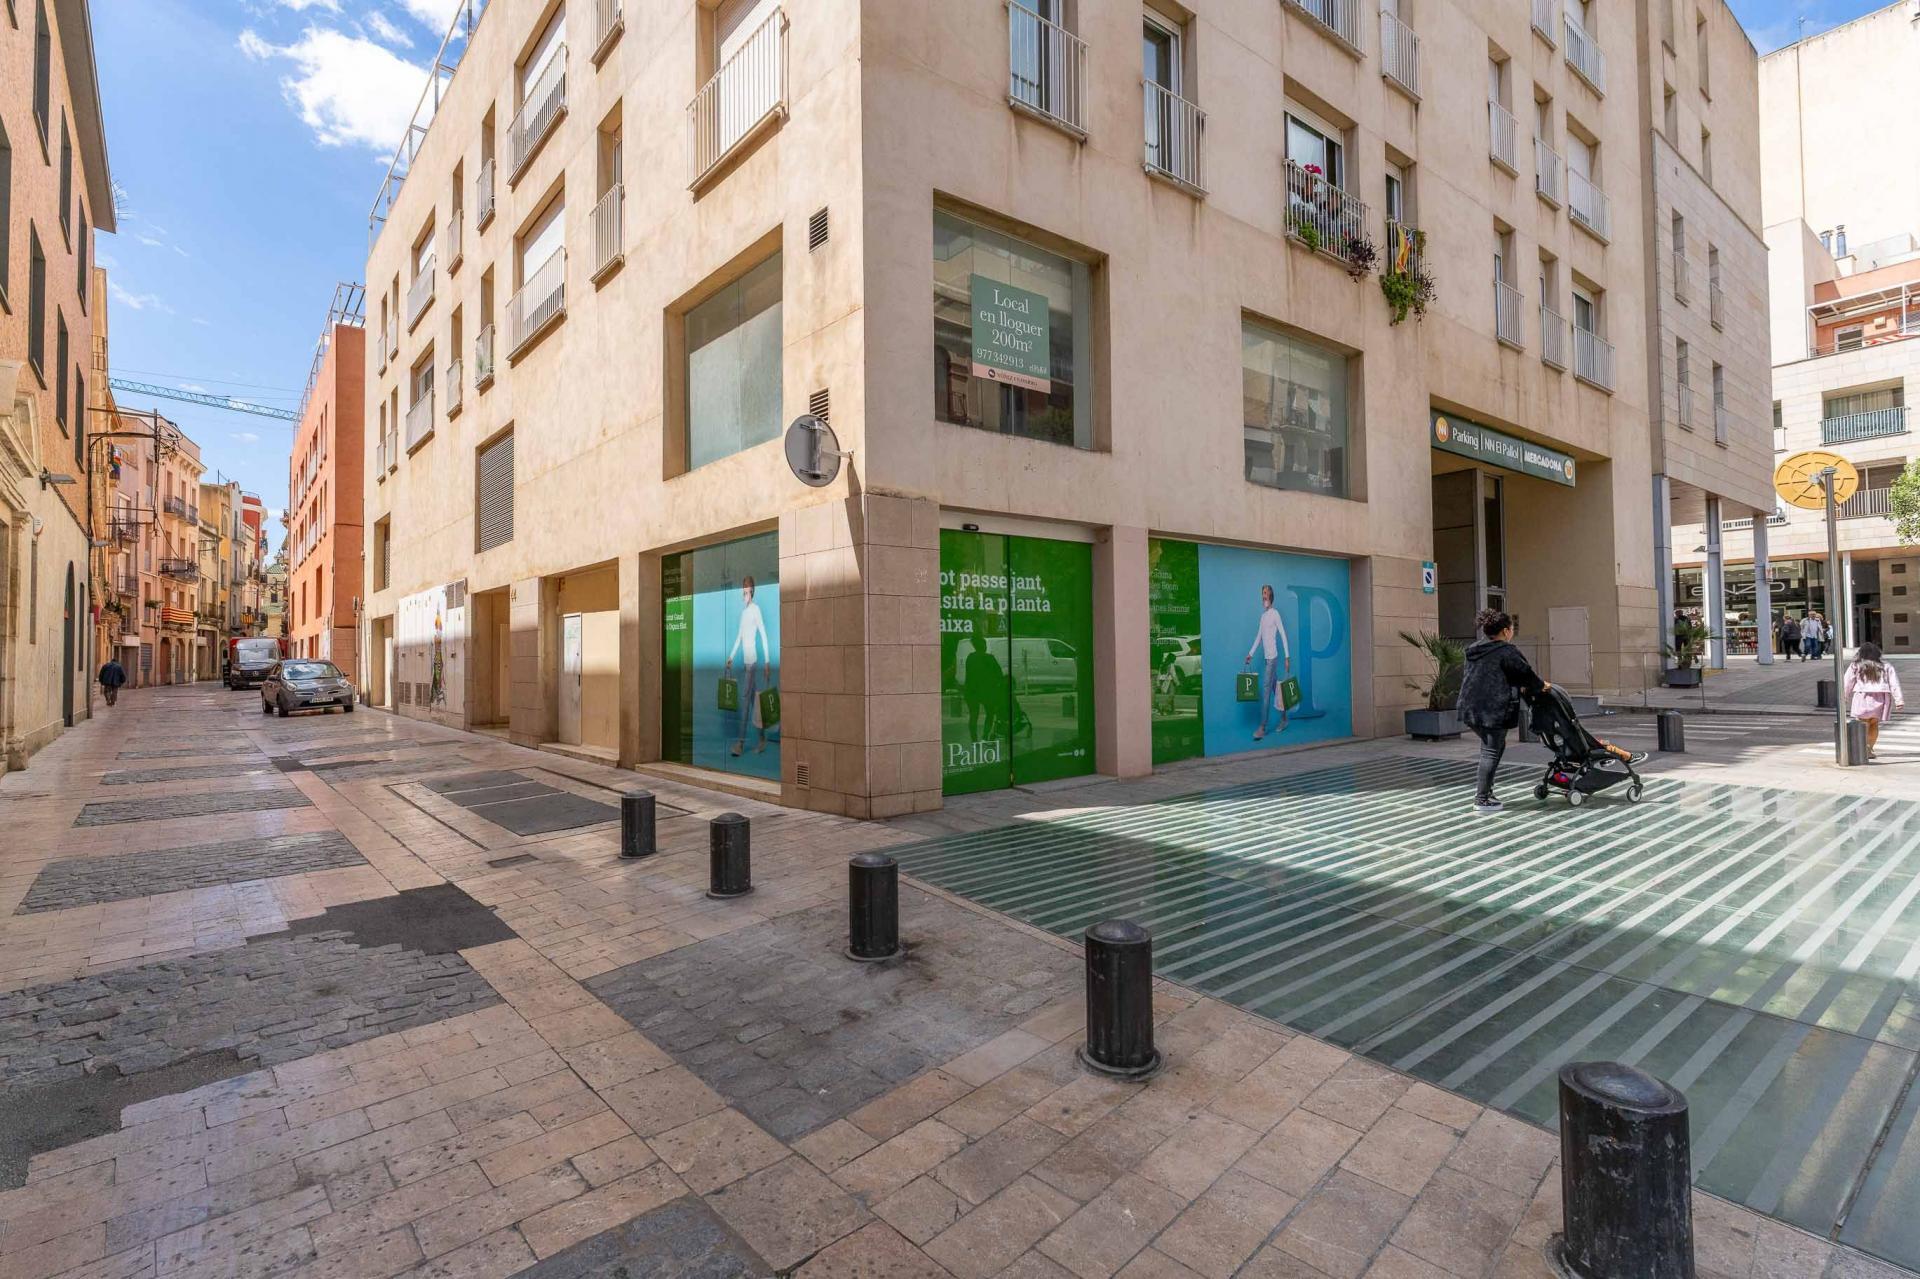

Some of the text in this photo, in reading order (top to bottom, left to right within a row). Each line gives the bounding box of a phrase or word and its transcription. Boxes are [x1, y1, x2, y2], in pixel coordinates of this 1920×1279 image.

[993, 289, 1029, 314] Local
[980, 310, 1043, 336] en lloguer
[976, 348, 1024, 368] 977342913
[1452, 427, 1479, 450] Parking
[1524, 450, 1562, 472] MERCADONA
[959, 571, 1046, 594] passejant,
[978, 592, 994, 610] la
[998, 593, 1051, 616] planta
[1286, 583, 1346, 719] P
[948, 740, 1001, 767] Pallol
